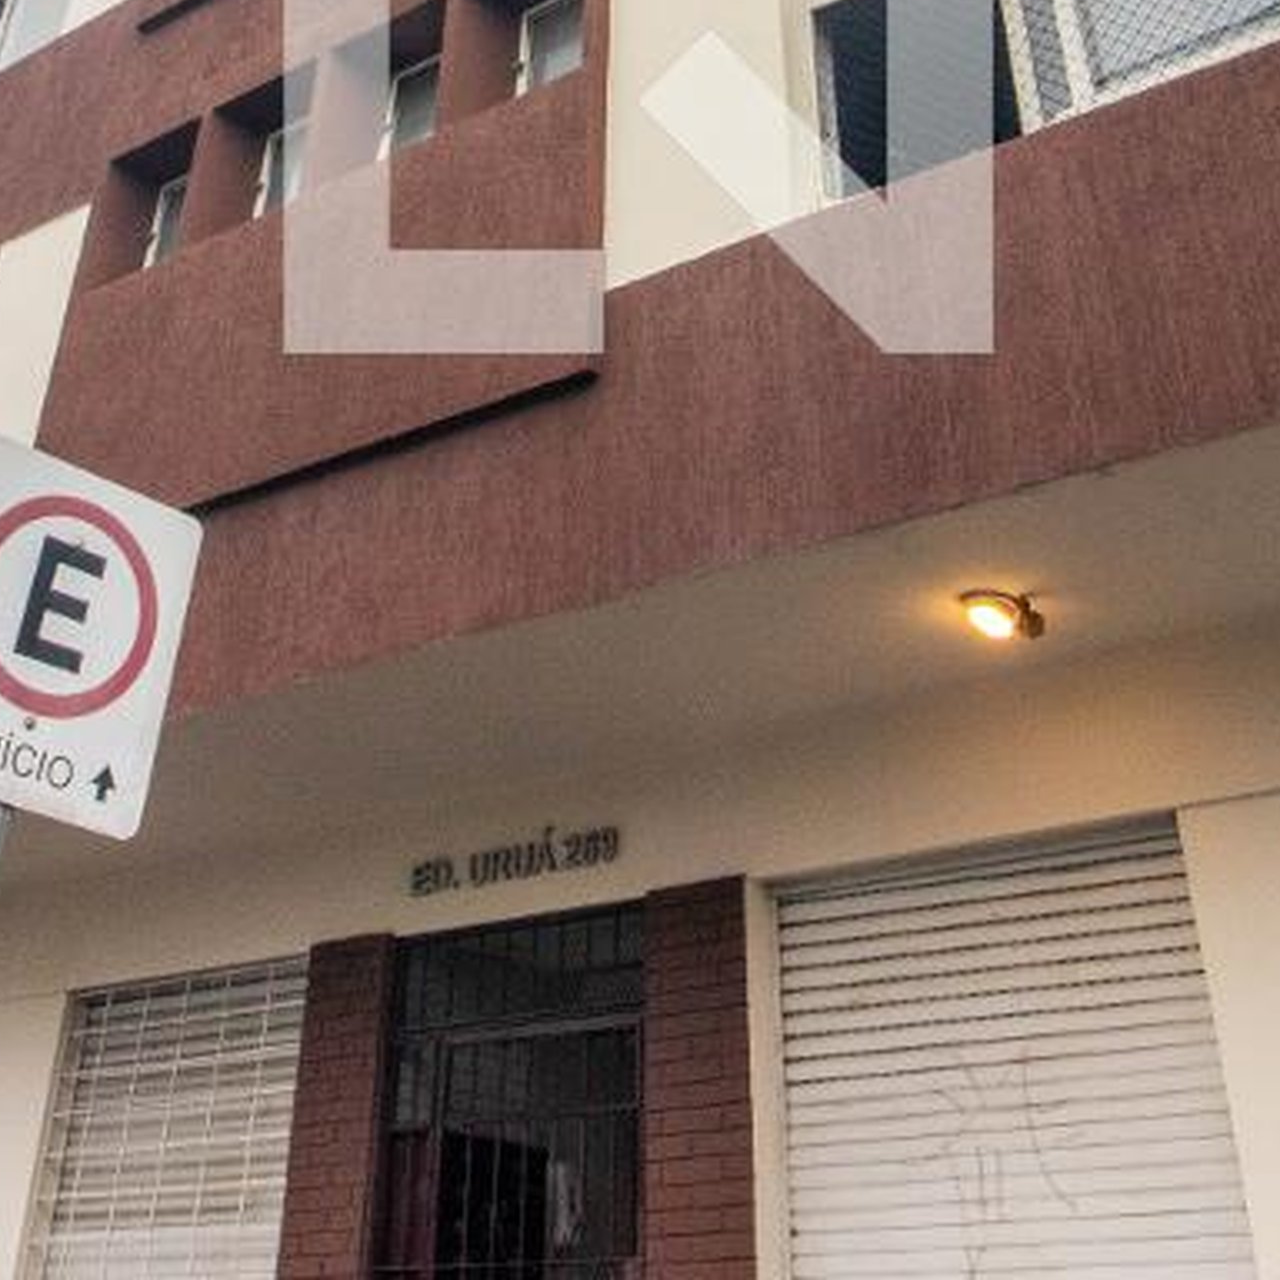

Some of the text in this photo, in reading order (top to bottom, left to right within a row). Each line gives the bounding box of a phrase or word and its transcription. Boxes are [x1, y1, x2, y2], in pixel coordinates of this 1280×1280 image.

[13, 535, 107, 675] E
[409, 857, 460, 897] ED.
[468, 825, 558, 888] URUÁ
